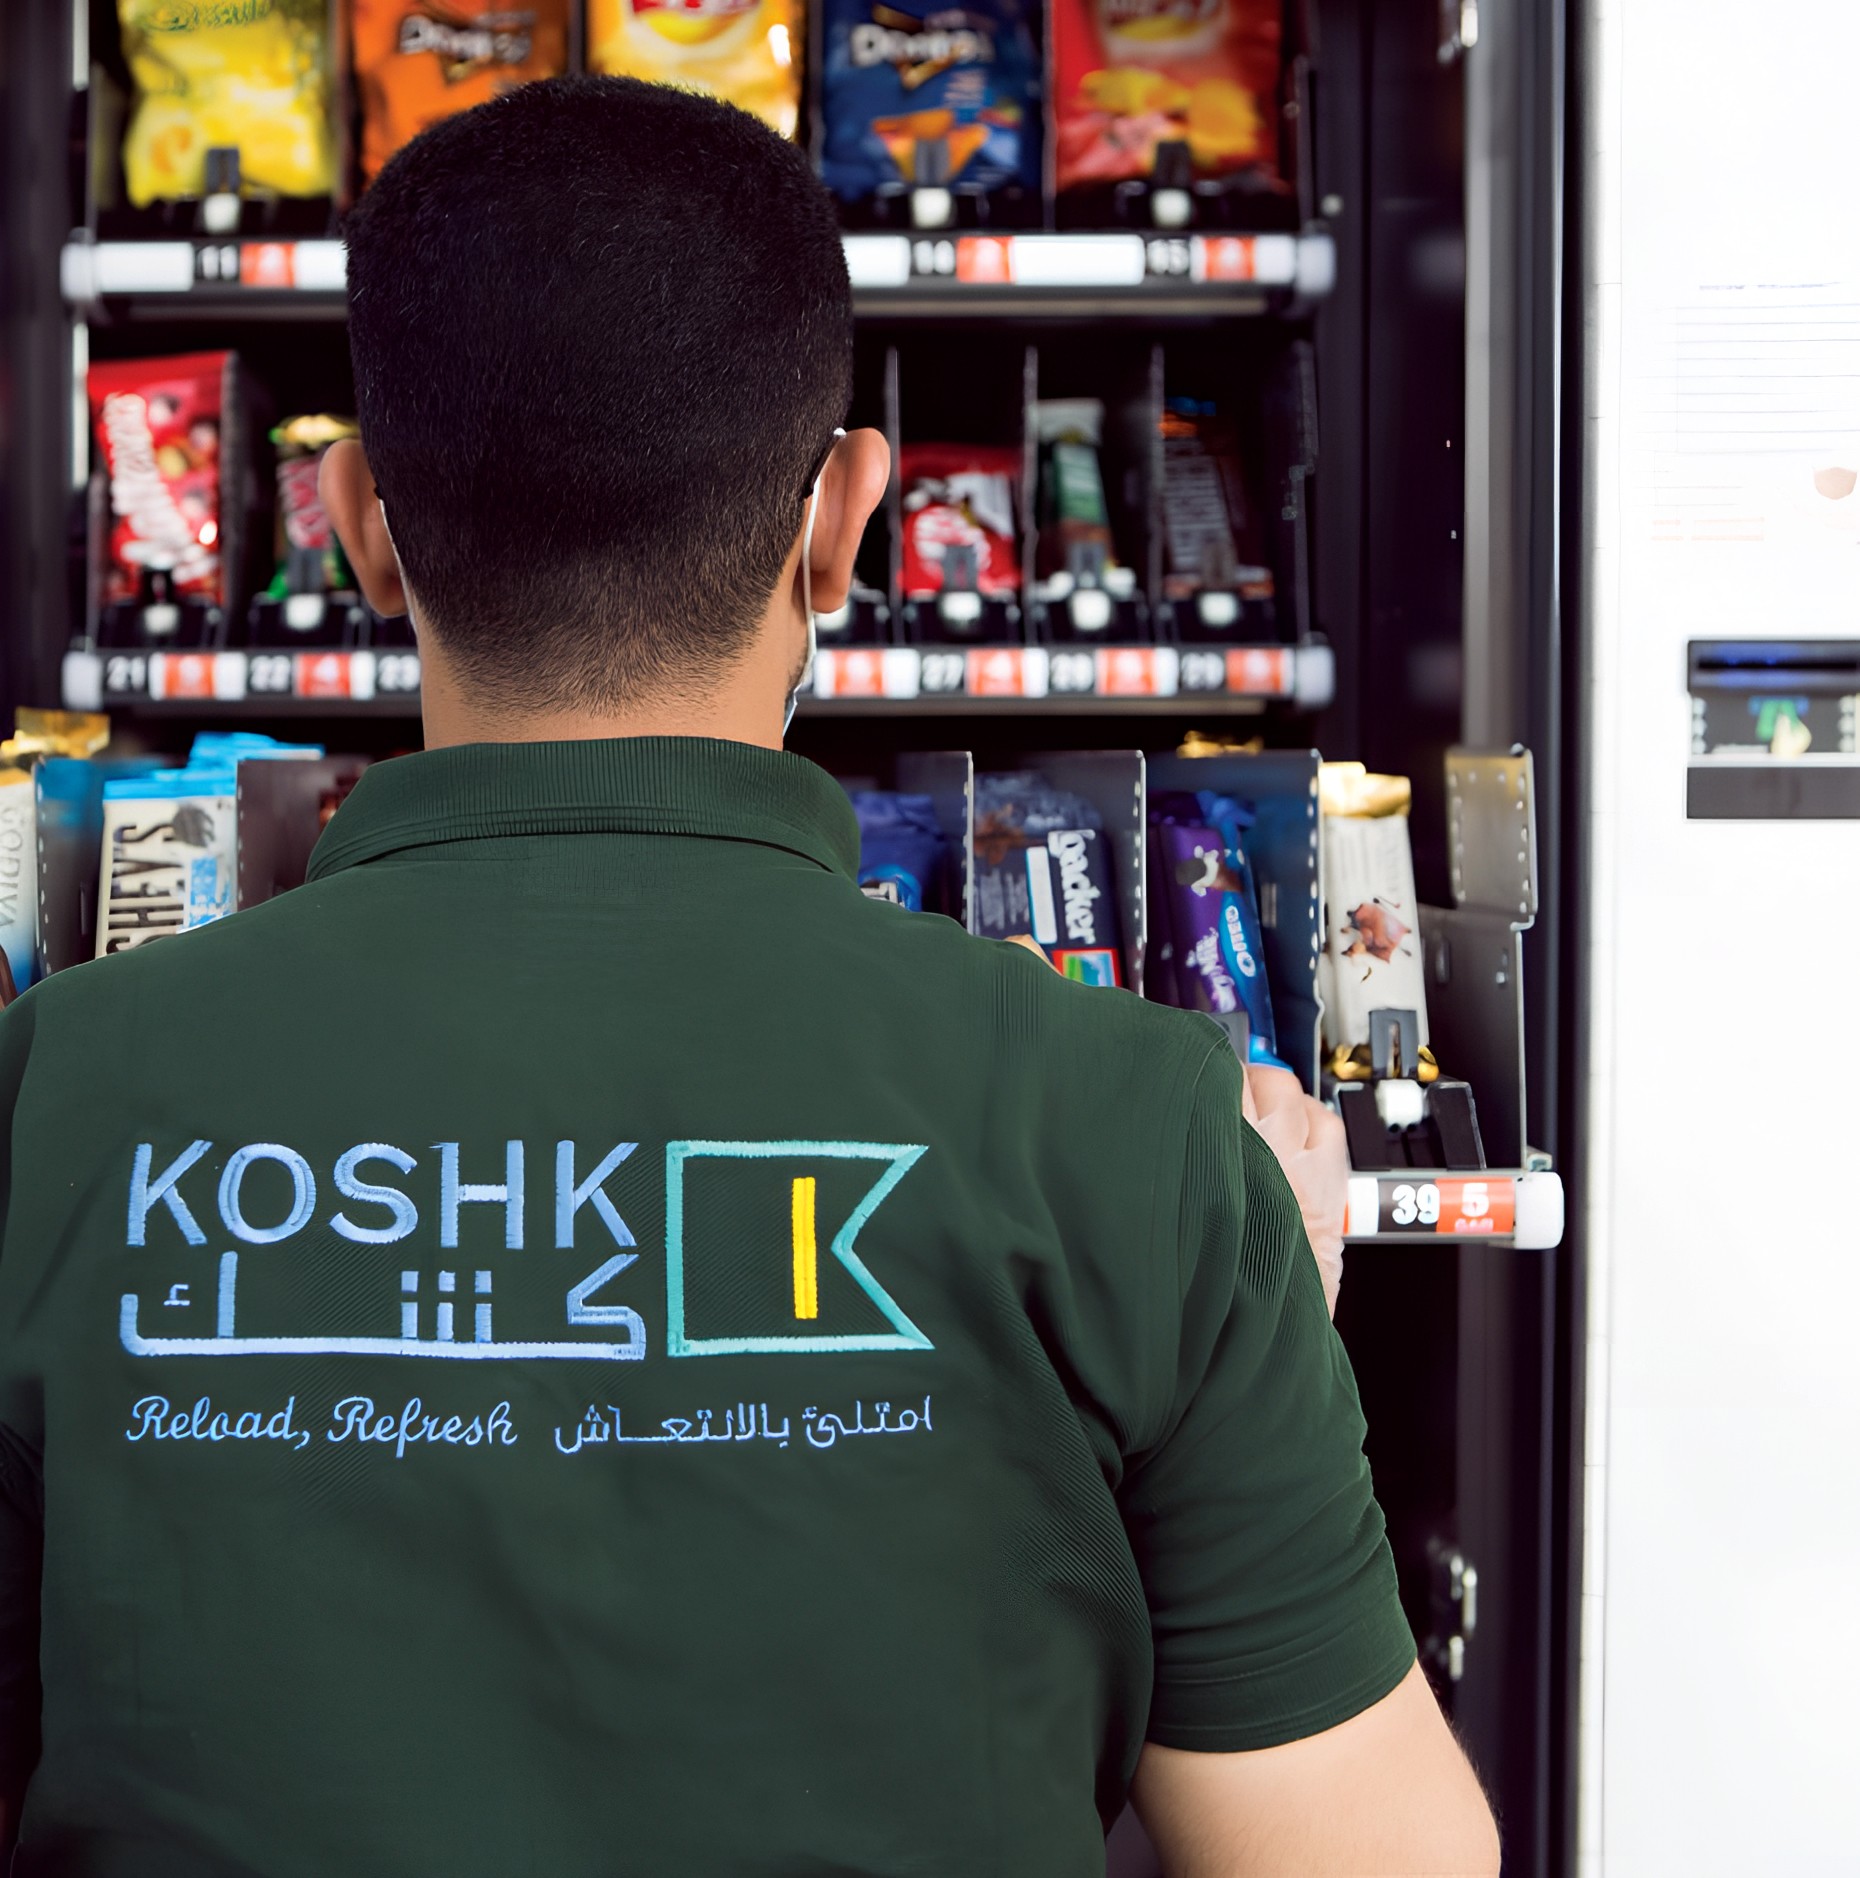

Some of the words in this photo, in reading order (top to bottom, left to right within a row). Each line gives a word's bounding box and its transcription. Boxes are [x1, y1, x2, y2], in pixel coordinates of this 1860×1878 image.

[126, 1139, 640, 1250] KOSHK
[1391, 1183, 1441, 1225] 39
[1461, 1182, 1490, 1217] 5
[125, 1394, 312, 1450] Reload,
[327, 1395, 519, 1459] Refresh
